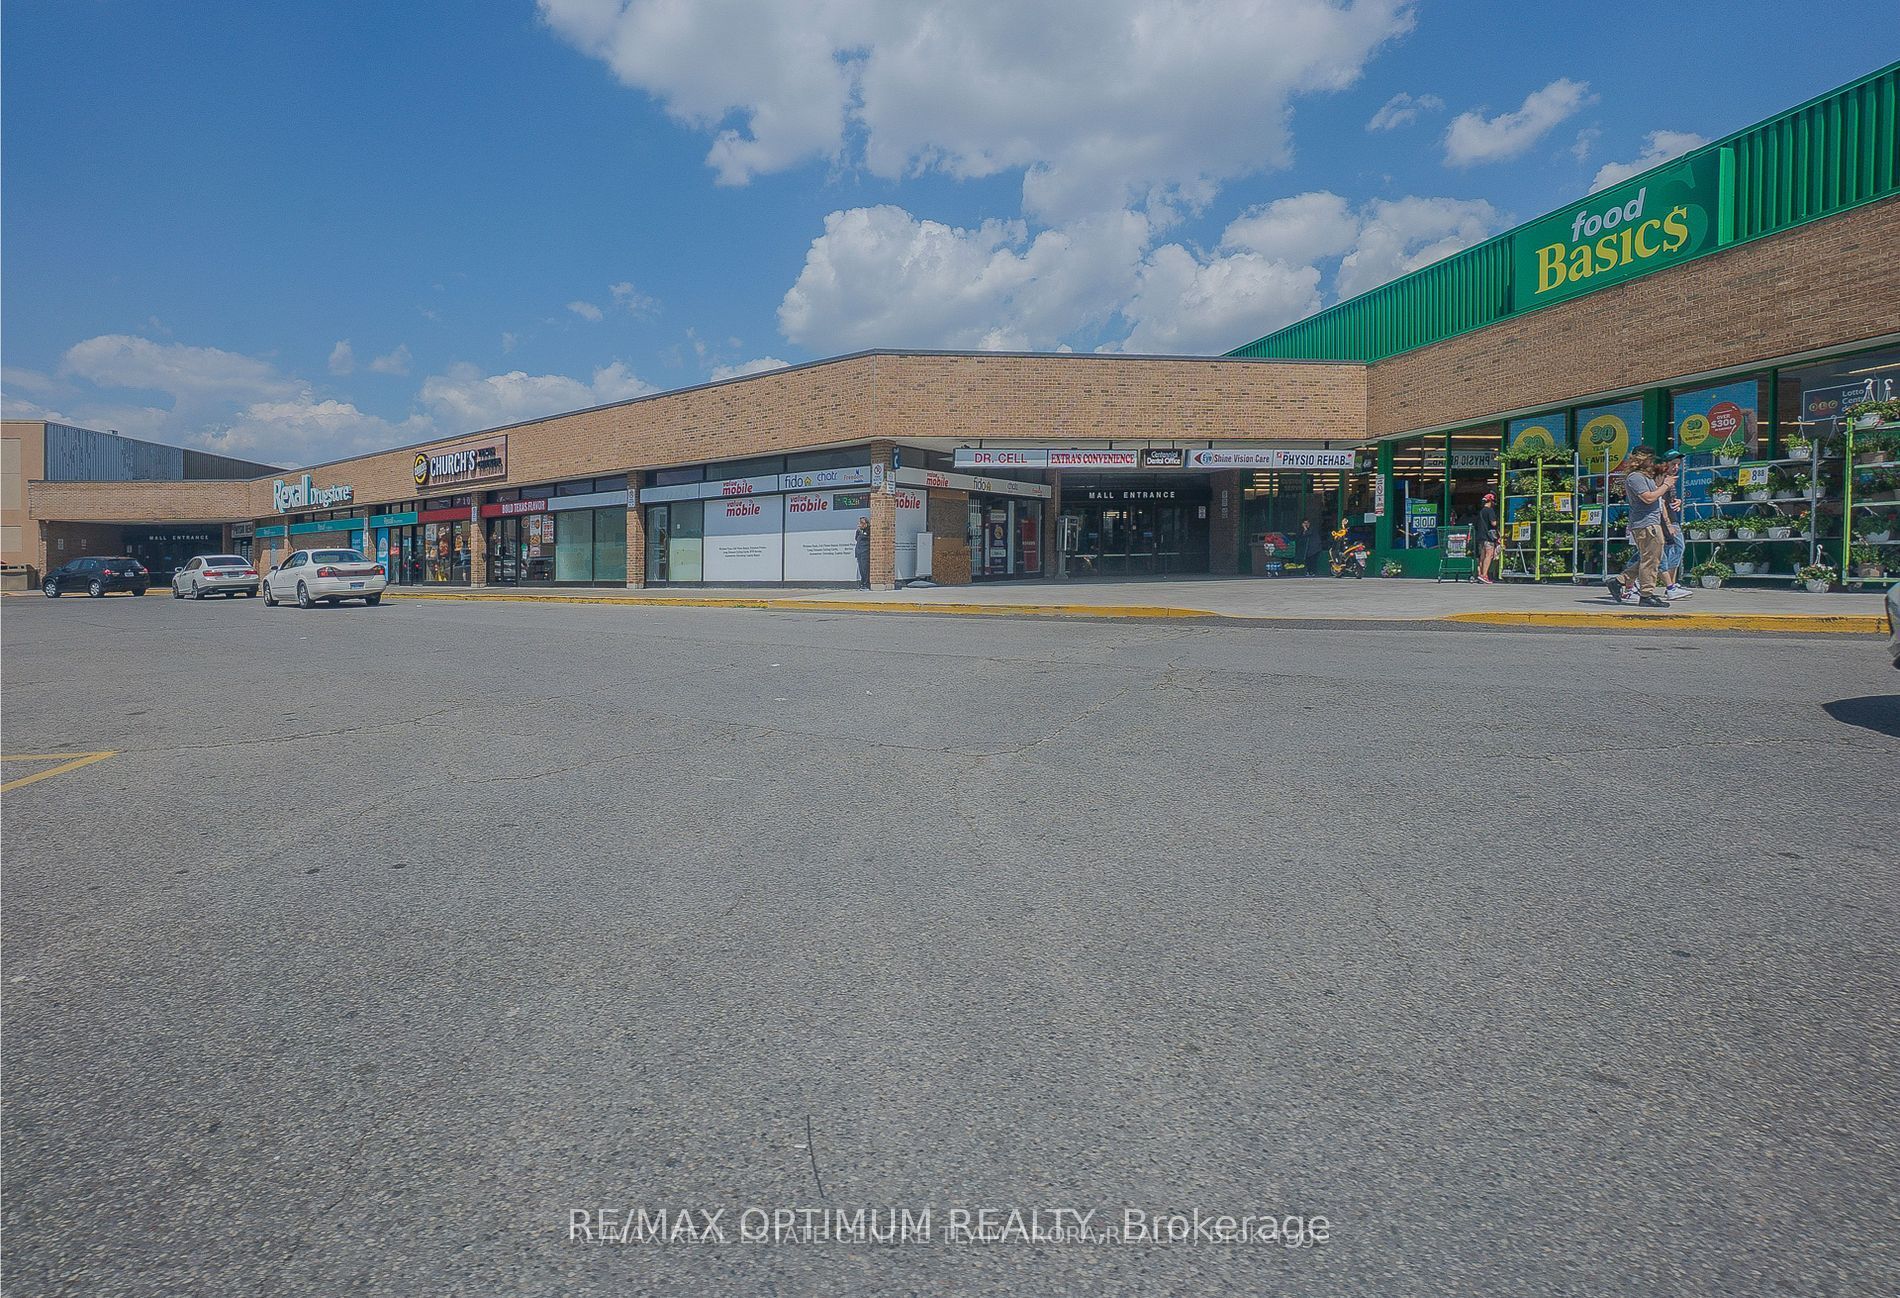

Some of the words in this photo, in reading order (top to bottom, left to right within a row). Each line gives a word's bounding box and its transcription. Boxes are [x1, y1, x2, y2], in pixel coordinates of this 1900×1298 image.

[1571, 187, 1647, 242] food
[1842, 389, 1864, 397] Lotto
[1711, 418, 1736, 429] $300
[1590, 424, 1617, 444] 30
[430, 450, 476, 477] CHURCH'S
[974, 453, 995, 463] DR.
[998, 453, 1028, 463] CELL
[1051, 453, 1082, 464] EXTRA'S
[1083, 453, 1135, 464] CONVENIENCE
[1213, 454, 1232, 463] Shine
[1233, 454, 1254, 463] Vision
[1255, 454, 1270, 463] Care
[1282, 454, 1315, 466] PHYSIO
[1316, 454, 1346, 466] REHAB
[785, 474, 804, 489] fido
[273, 474, 311, 513] Rexall
[722, 483, 753, 495] mobile
[1089, 491, 1115, 499] MALL
[1123, 491, 1176, 499] ENTRANCE
[726, 503, 761, 517] mobile
[790, 499, 828, 513] mobile
[1414, 517, 1436, 528] 300
